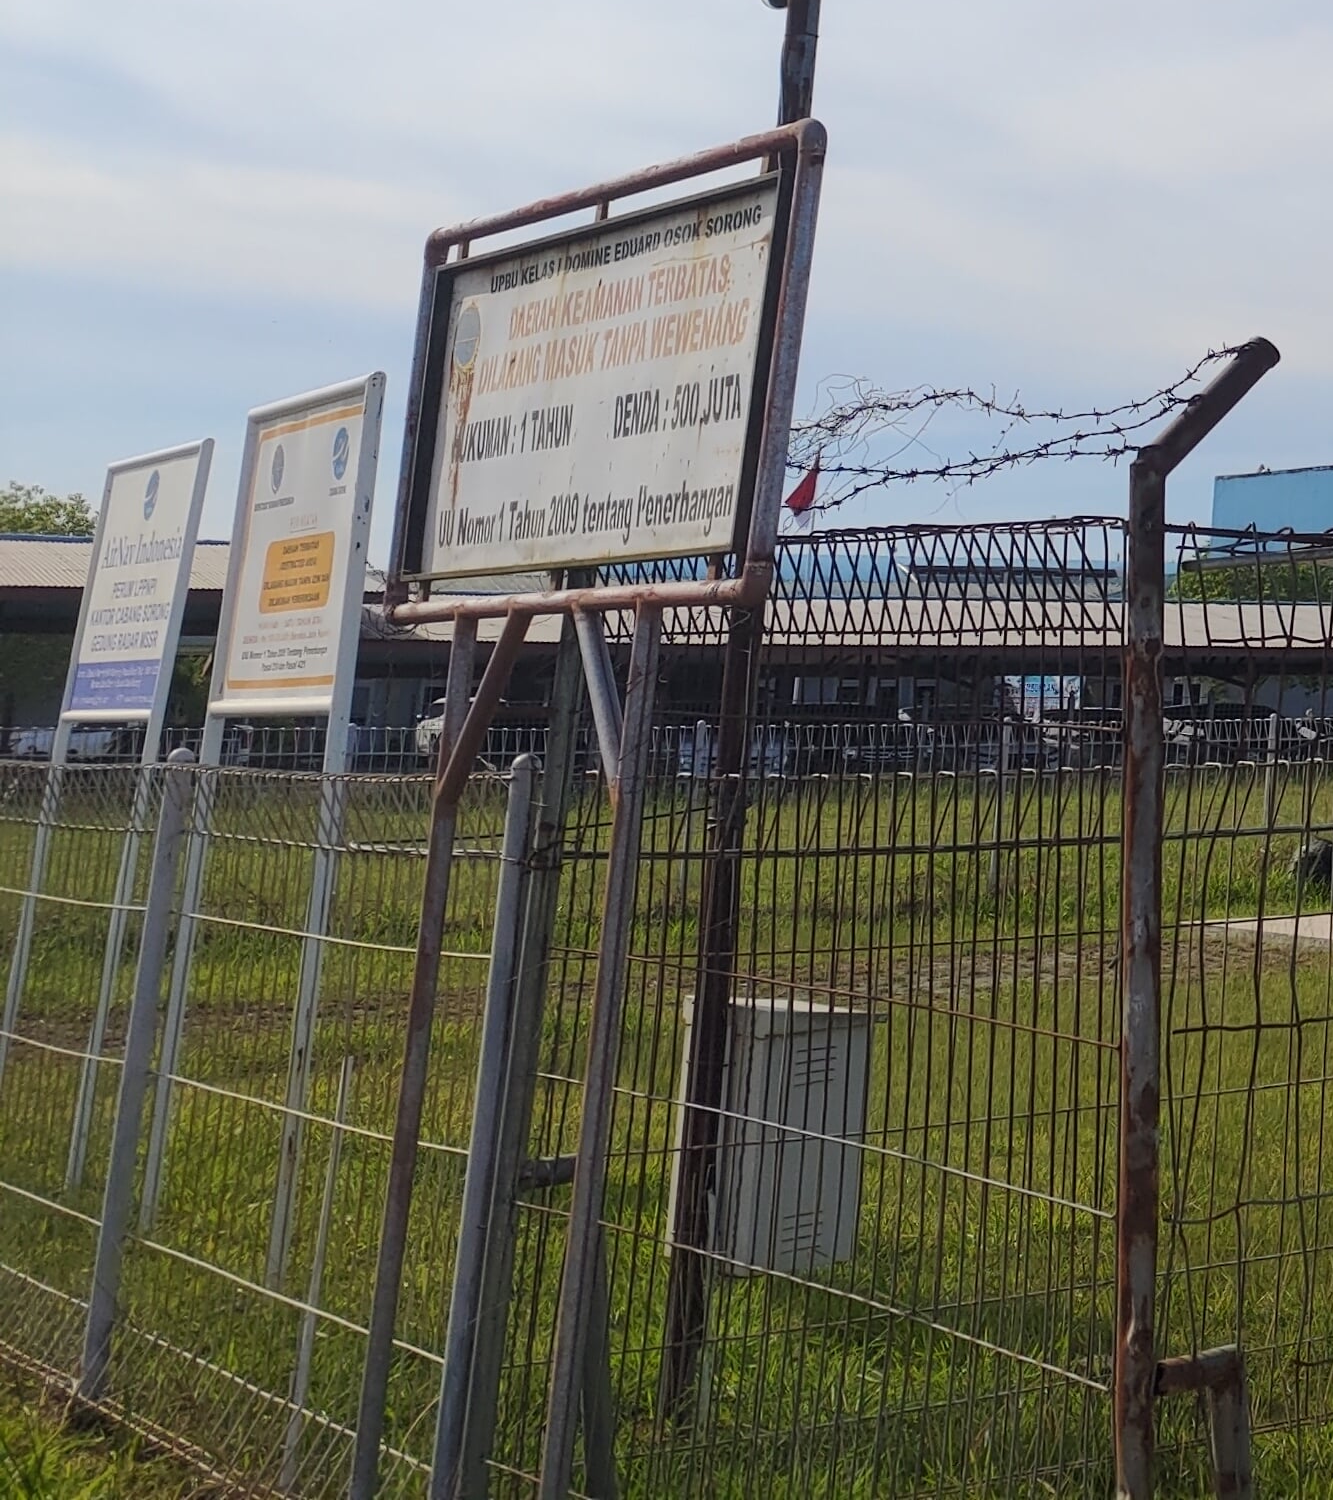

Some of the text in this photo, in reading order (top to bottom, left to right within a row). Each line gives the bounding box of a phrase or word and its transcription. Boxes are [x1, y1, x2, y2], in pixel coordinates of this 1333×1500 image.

[491, 269, 519, 293] UPBU
[520, 259, 555, 286] KELAS
[563, 245, 612, 273] DOMINE
[614, 231, 661, 261] EDUARD
[663, 219, 704, 246] OSOK
[704, 204, 762, 238] SORONG
[509, 253, 731, 340] DAERAH KEAMANAN TERBATAS
[477, 297, 750, 395] DILARANG MASUK TANPA WEWENANG
[531, 404, 574, 452] TAHUN
[613, 388, 660, 439] DENDA
[671, 381, 701, 430] 500
[703, 373, 741, 425] JUTA
[456, 507, 498, 546] Nomor
[498, 501, 505, 542] 1
[509, 499, 546, 540] Tahun
[547, 492, 580, 536] 2009
[582, 491, 633, 545] tentang
